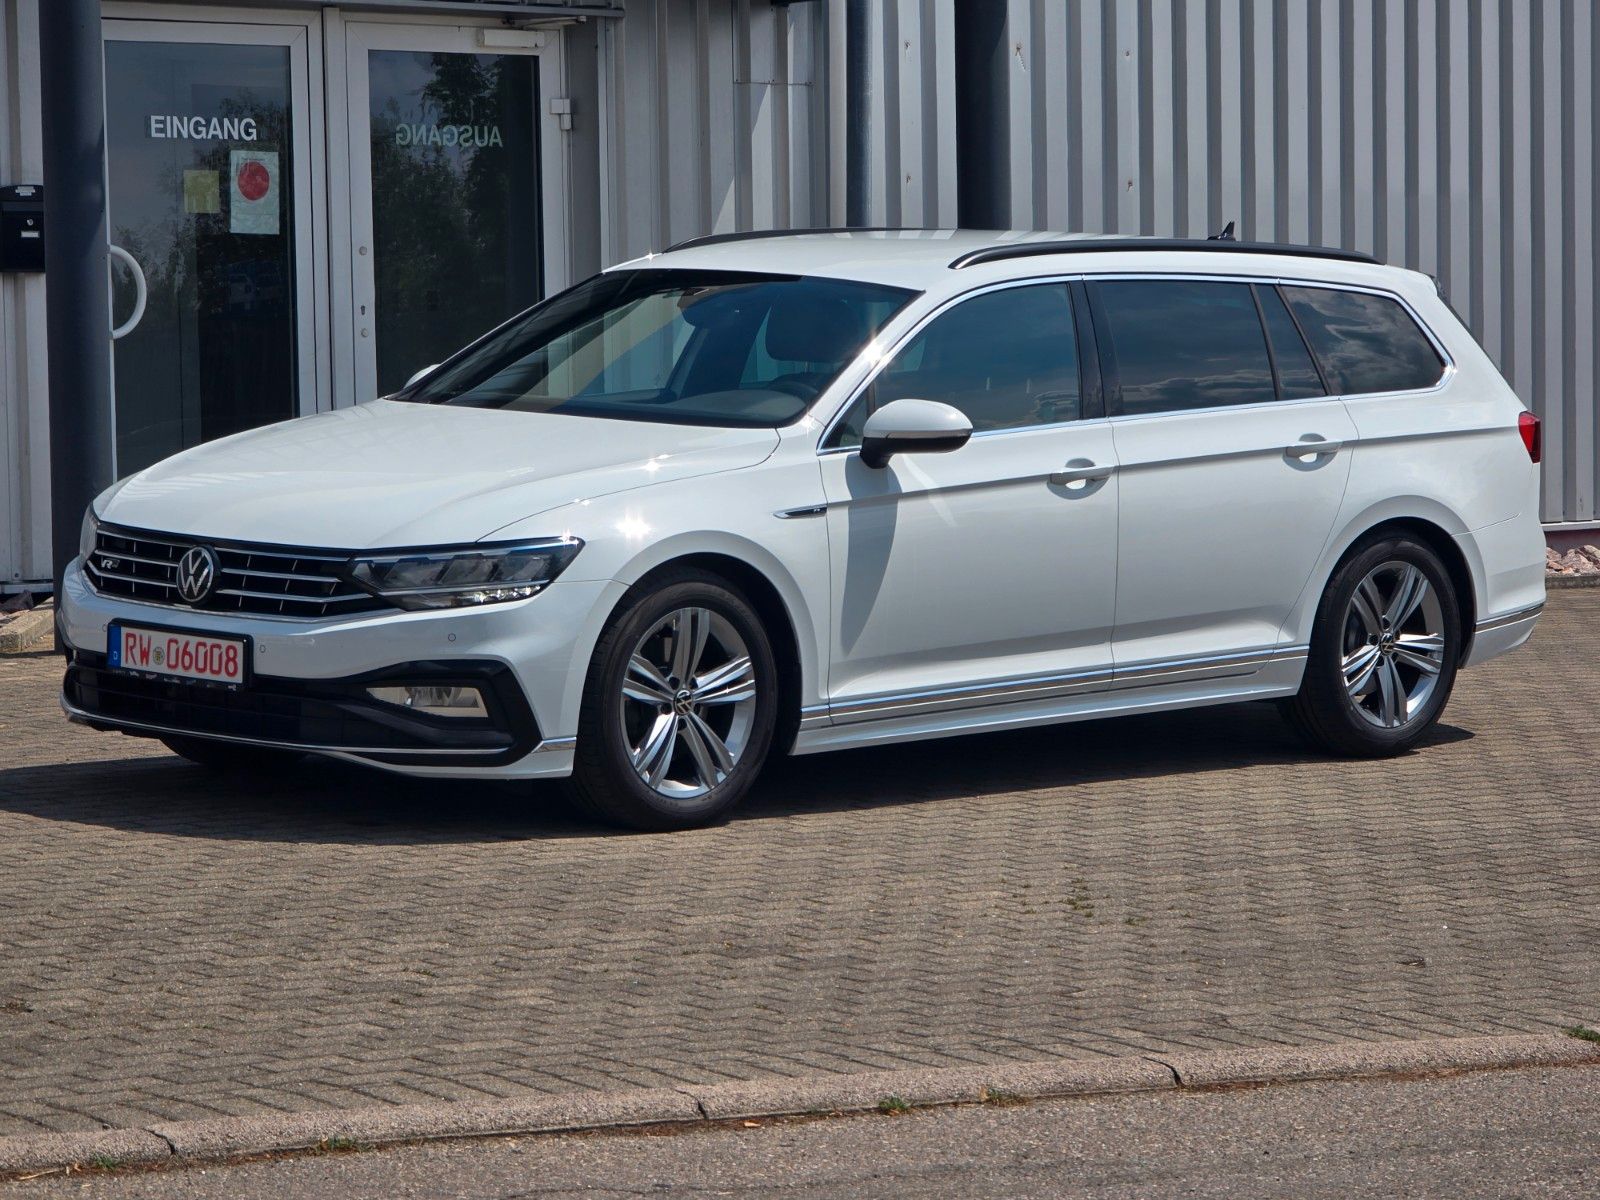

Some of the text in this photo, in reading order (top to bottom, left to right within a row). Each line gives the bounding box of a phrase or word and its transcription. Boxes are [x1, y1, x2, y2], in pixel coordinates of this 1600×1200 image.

[150, 114, 258, 142] EINGANG
[125, 632, 238, 677] RW 06008
